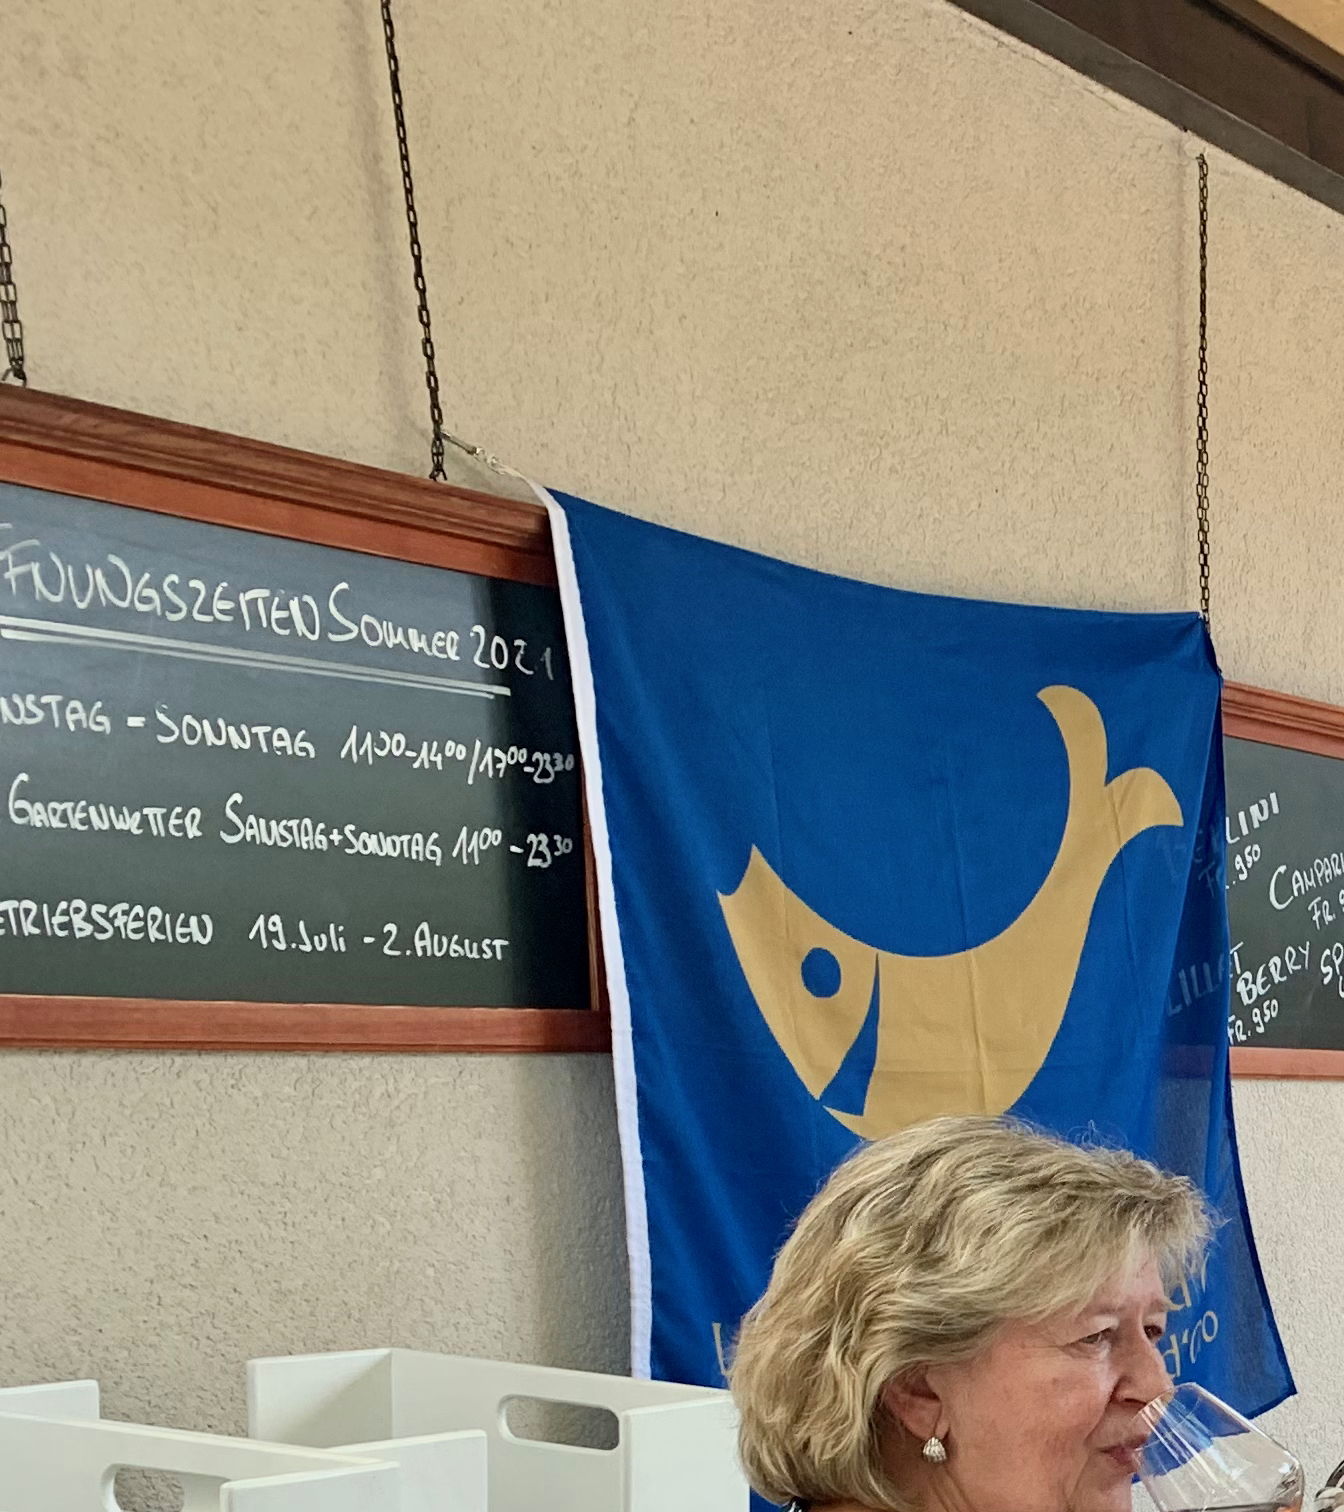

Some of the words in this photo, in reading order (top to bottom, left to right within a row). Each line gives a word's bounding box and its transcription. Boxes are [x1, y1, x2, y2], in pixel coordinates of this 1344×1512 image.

[0, 524, 320, 640] FNUNGSZEITEN
[469, 624, 554, 680] 2021
[155, 703, 315, 758] SONNTAG
[0, 899, 213, 945] TRIEBSFERIEN
[1236, 941, 1309, 1006] BERRY
